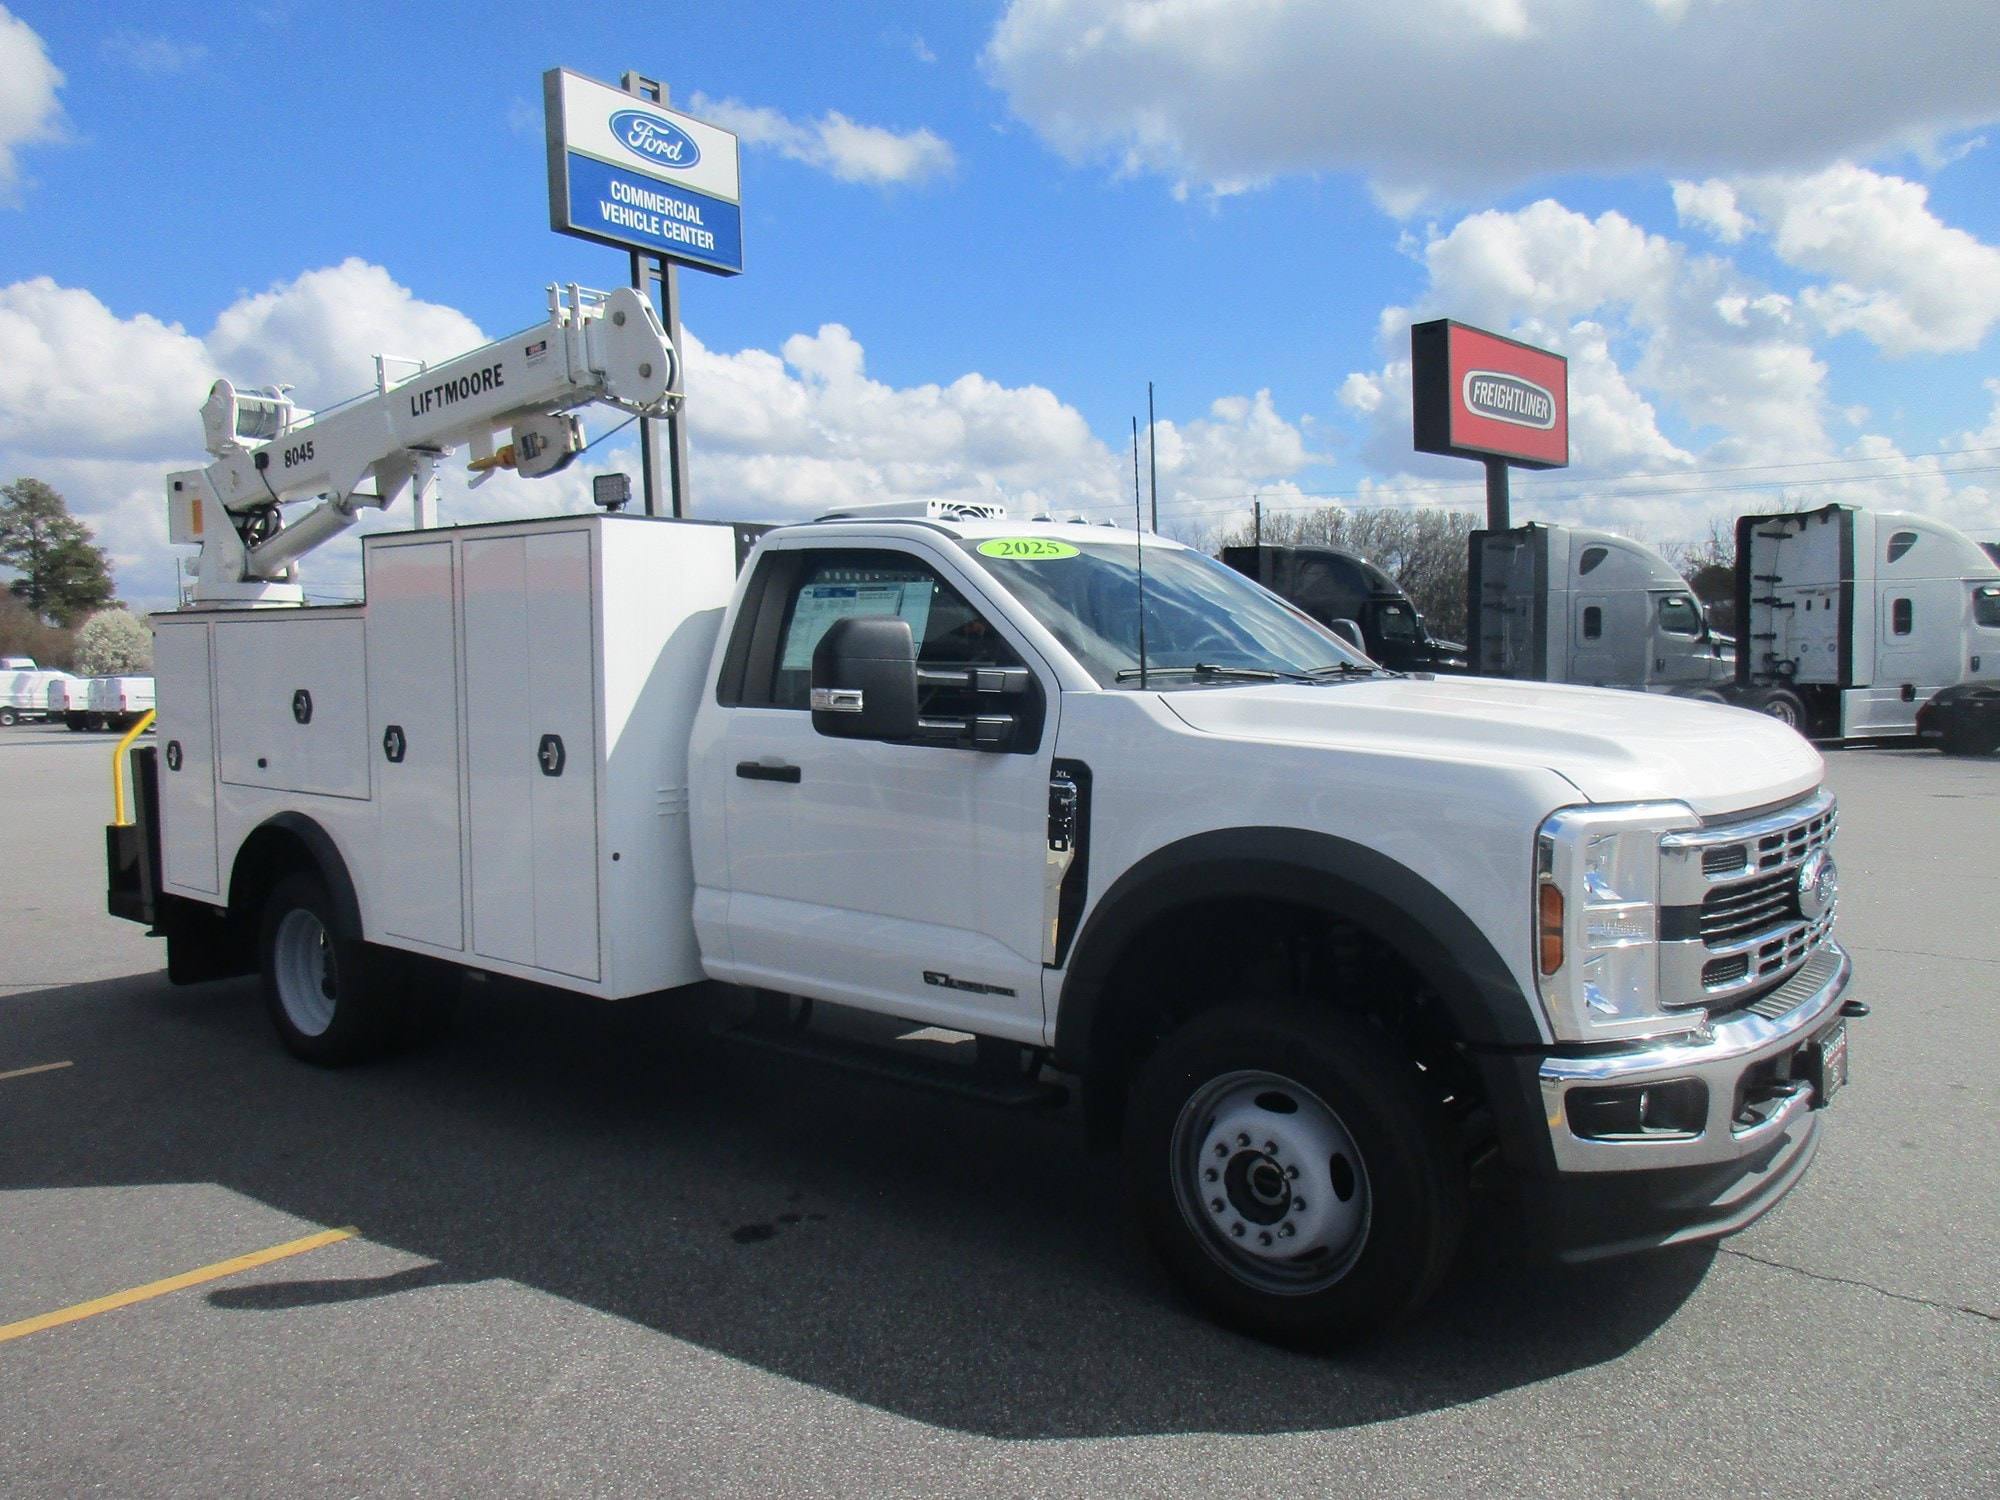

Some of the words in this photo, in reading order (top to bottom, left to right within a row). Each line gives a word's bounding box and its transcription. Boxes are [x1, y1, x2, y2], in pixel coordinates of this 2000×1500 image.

[628, 119, 683, 161] Ford
[610, 180, 704, 226] COMMERCIAL
[600, 200, 660, 236] VEHICLE
[663, 219, 715, 251] CENTER
[411, 363, 504, 417] LIFTMOORE
[1473, 381, 1548, 419] FREIGHTLINER
[285, 440, 314, 468] 8045
[998, 542, 1060, 556] 2025
[1055, 770, 1071, 779] XL
